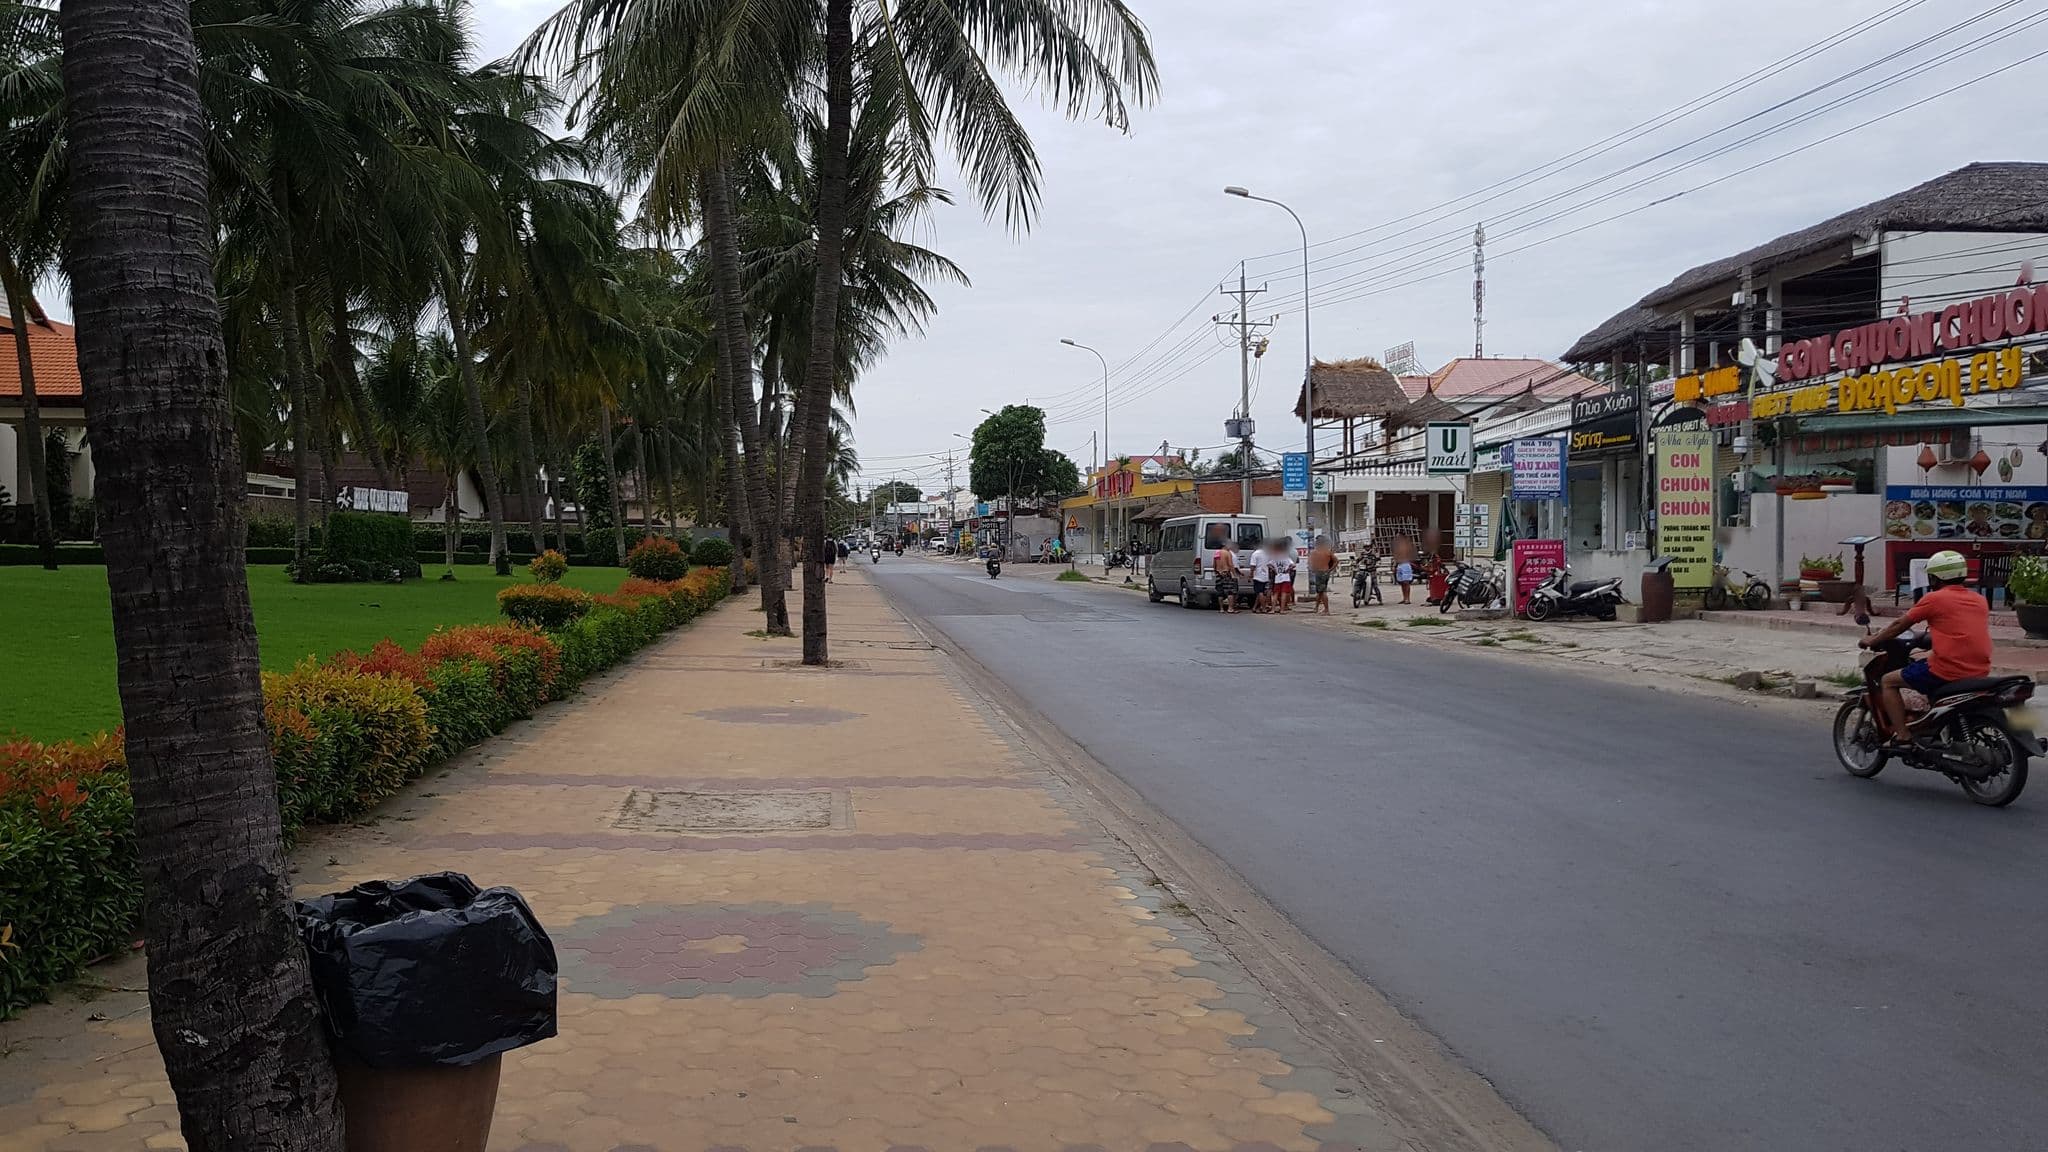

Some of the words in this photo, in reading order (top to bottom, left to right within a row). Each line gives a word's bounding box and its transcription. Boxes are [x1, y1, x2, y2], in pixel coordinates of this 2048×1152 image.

[1778, 334, 1831, 381] CON
[1838, 359, 1965, 416] DRAGON
[1970, 346, 2023, 394] FLY
[1442, 429, 1457, 453] U
[1572, 431, 1603, 450] Spring
[1431, 451, 1467, 466] mart
[1670, 453, 1700, 468] CON
